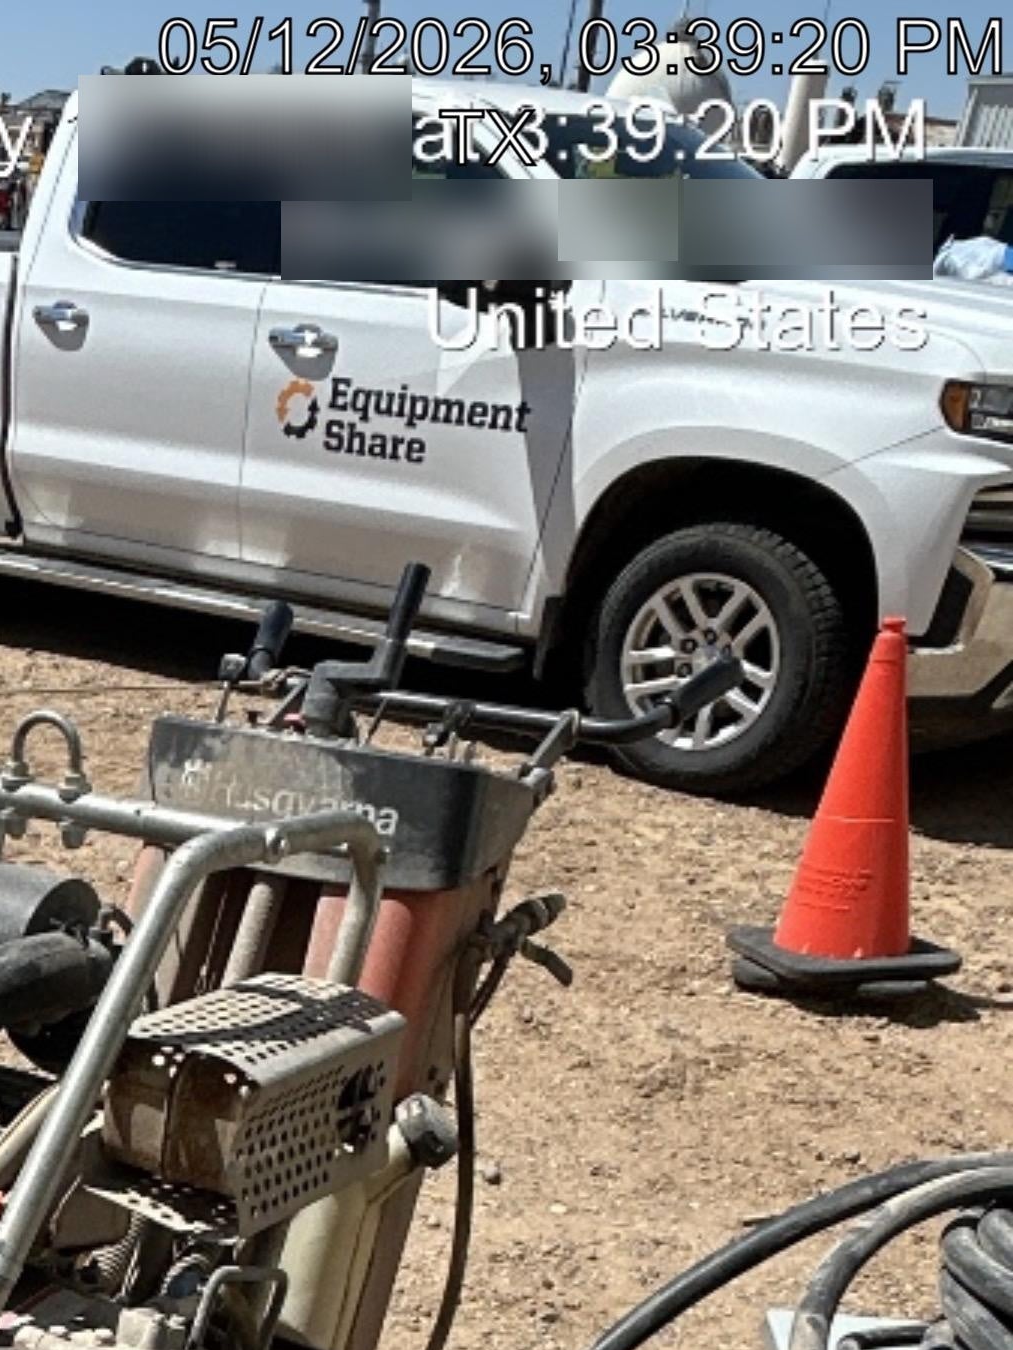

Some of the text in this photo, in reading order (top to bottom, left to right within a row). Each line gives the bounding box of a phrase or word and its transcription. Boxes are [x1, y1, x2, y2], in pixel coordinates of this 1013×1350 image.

[328, 377, 531, 433] Equipment
[323, 419, 426, 463] Share
[207, 772, 400, 836] sqvarna
